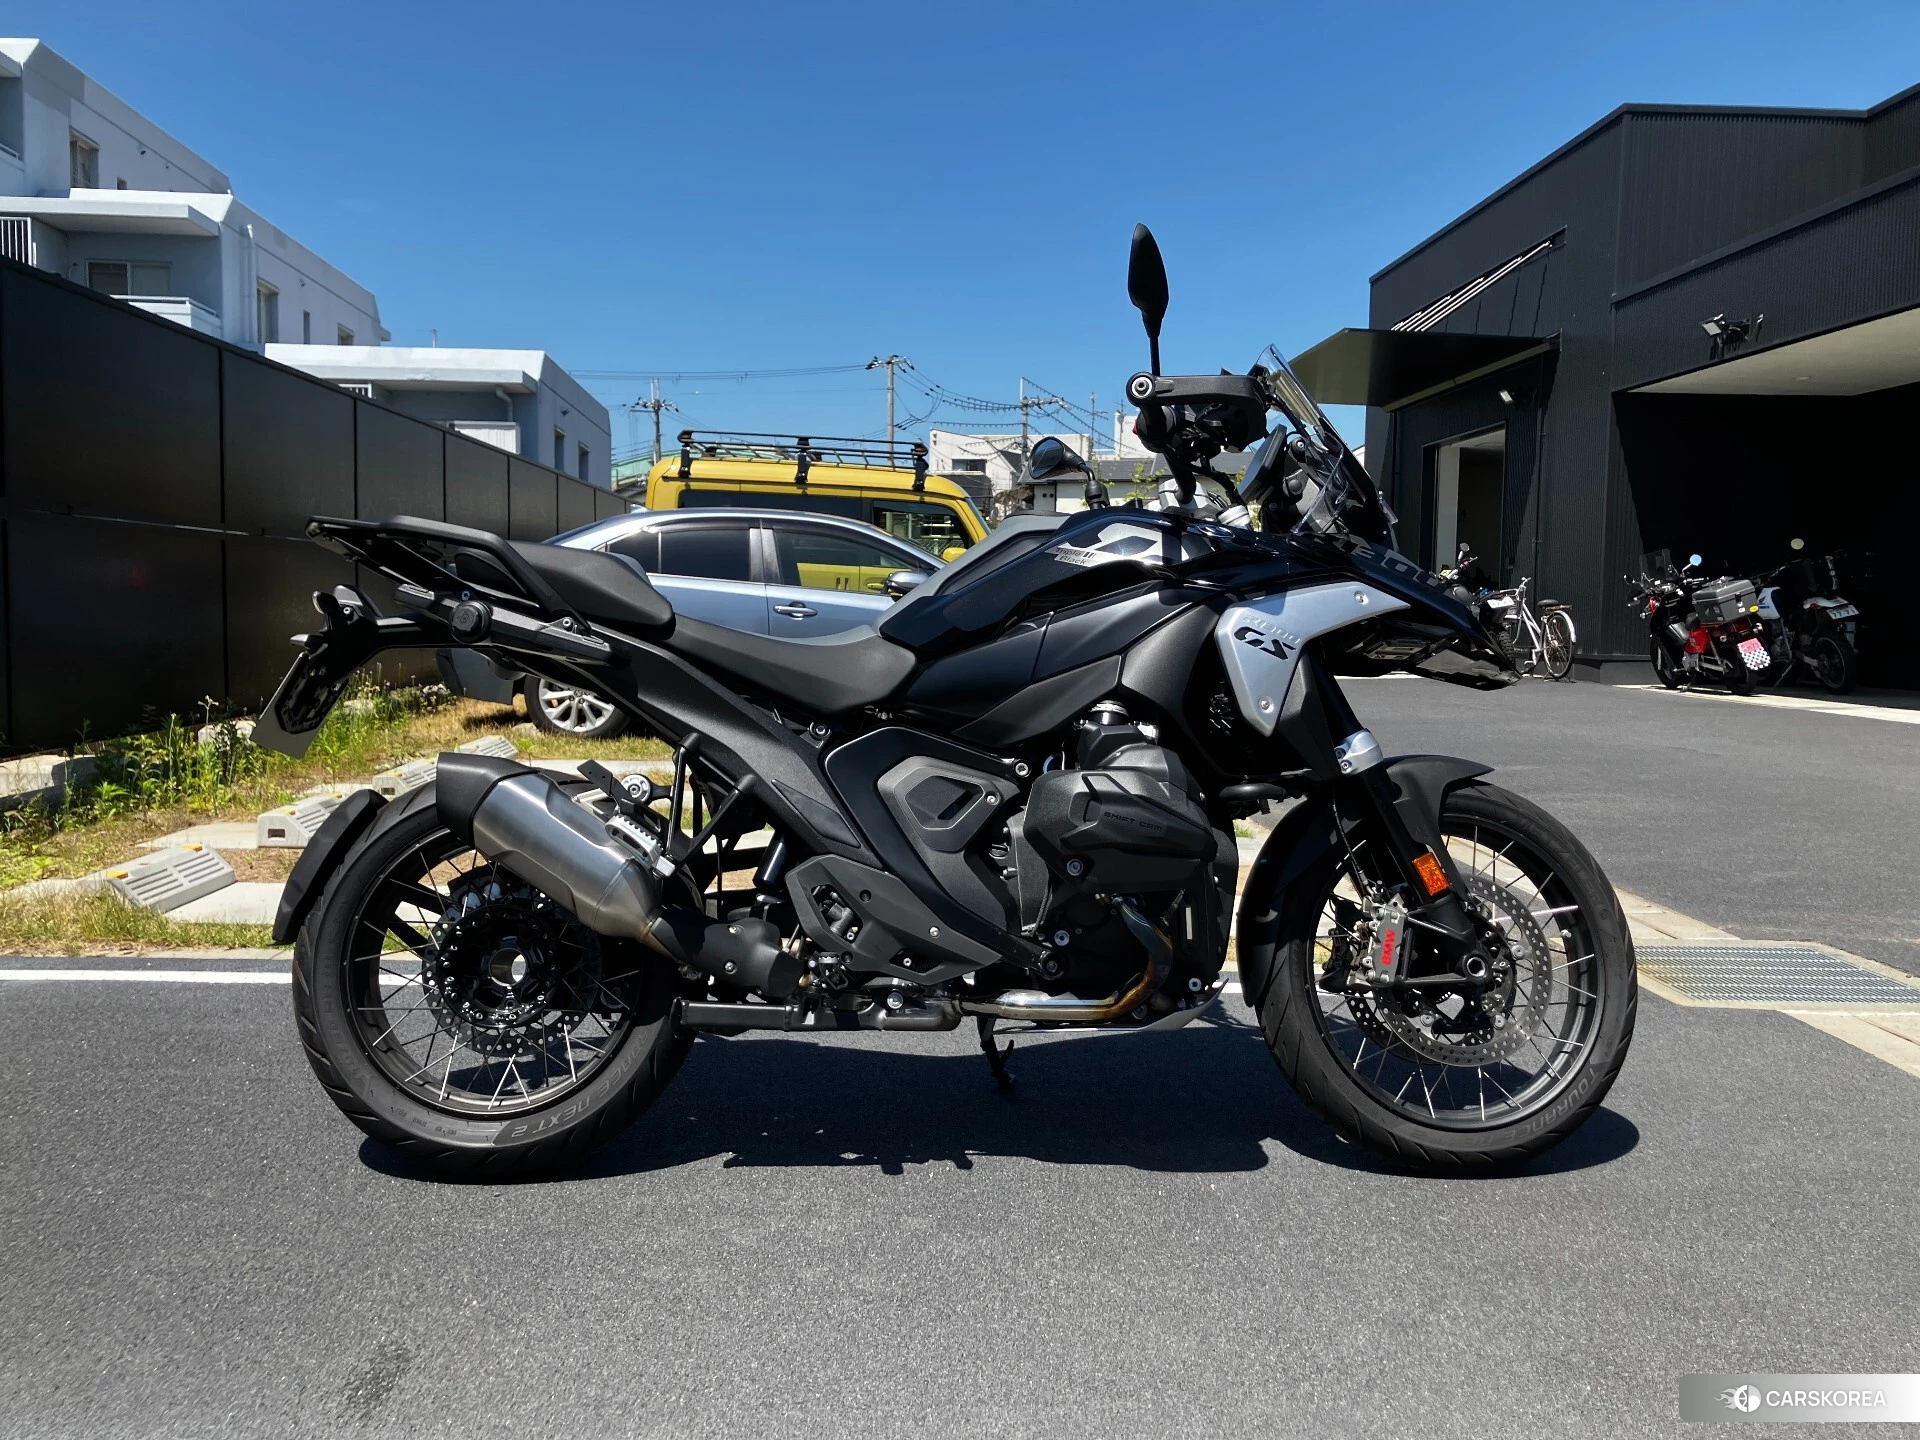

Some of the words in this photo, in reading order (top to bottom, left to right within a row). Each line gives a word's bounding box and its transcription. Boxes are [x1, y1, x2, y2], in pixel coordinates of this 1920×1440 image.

[1055, 547, 1082, 557] Triple
[1060, 555, 1087, 565] Black
[1233, 626, 1297, 661] GS
[1103, 811, 1136, 824] SHIFT
[1381, 927, 1397, 967] BMW
[1503, 1067, 1600, 1141] TOURANCE
